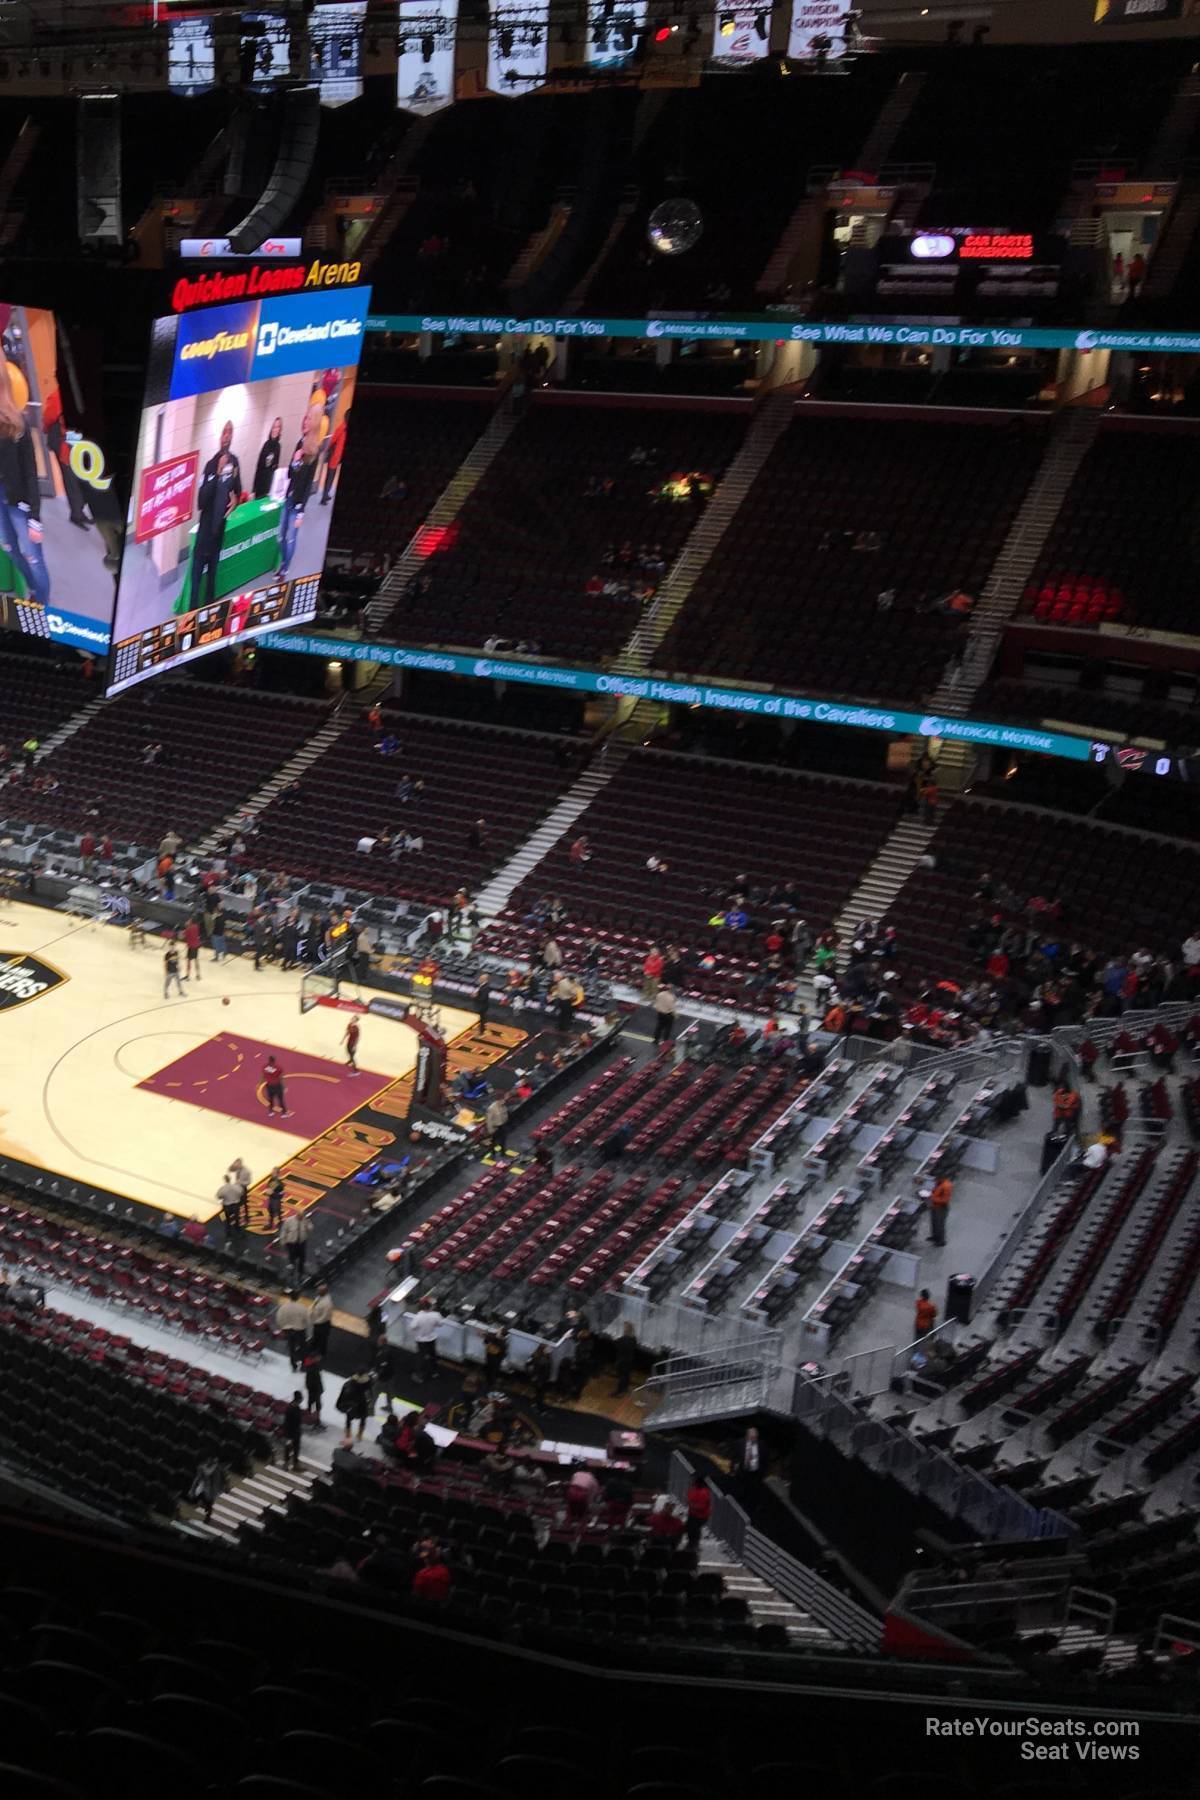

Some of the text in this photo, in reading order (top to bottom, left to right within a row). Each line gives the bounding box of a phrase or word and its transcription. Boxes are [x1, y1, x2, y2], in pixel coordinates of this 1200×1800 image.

[965, 235, 1032, 246] CAR PARTS
[172, 259, 362, 312] Quicken Loans Arena
[421, 317, 605, 335] See What We Can Do For You
[665, 324, 748, 336] MEDICAL MUTUAL
[791, 325, 1023, 346] See What We Can Do For You
[180, 318, 362, 360] GOODYEAR Cleveland Clinic
[1099, 334, 1151, 347] MEDICAL
[267, 635, 307, 652] Health
[309, 639, 352, 657] Insurer
[354, 643, 369, 658] of
[370, 645, 392, 661] the
[393, 650, 456, 671] Cavaliers
[494, 664, 577, 684] MEDICAL MUTUAL
[596, 675, 896, 729] Official Health Insurer of the Cavaliers
[943, 722, 1052, 749] MEDICAL MUTUAL
